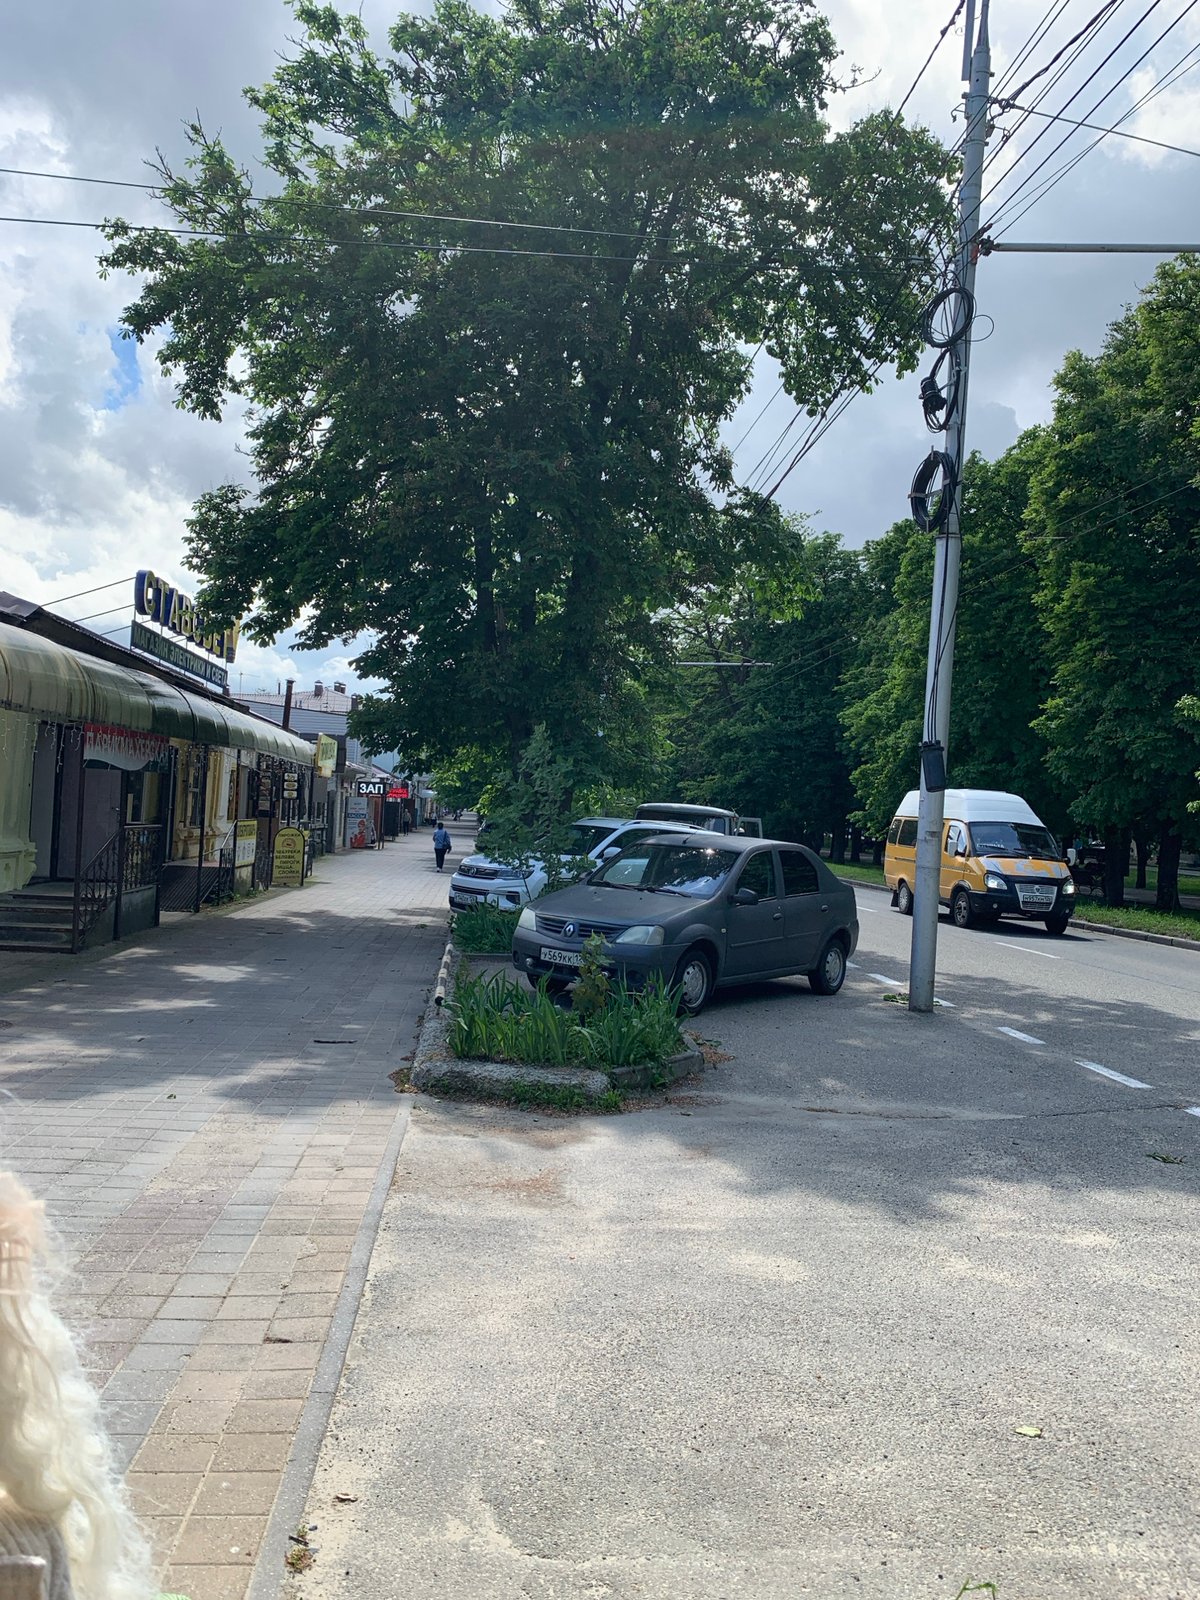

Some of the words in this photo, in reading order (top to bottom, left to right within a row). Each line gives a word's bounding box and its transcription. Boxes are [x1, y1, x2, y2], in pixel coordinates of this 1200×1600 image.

[133, 624, 169, 659] МАГАЗИН
[169, 647, 206, 676] ЭЛЕКТРИКИ
[206, 668, 211, 679] И
[211, 668, 228, 686] СВЕТА
[86, 731, 169, 763] ПАРИКМАХЕРСКАЯ
[359, 783, 384, 794] ЗАП
[543, 950, 573, 964] У569КК
